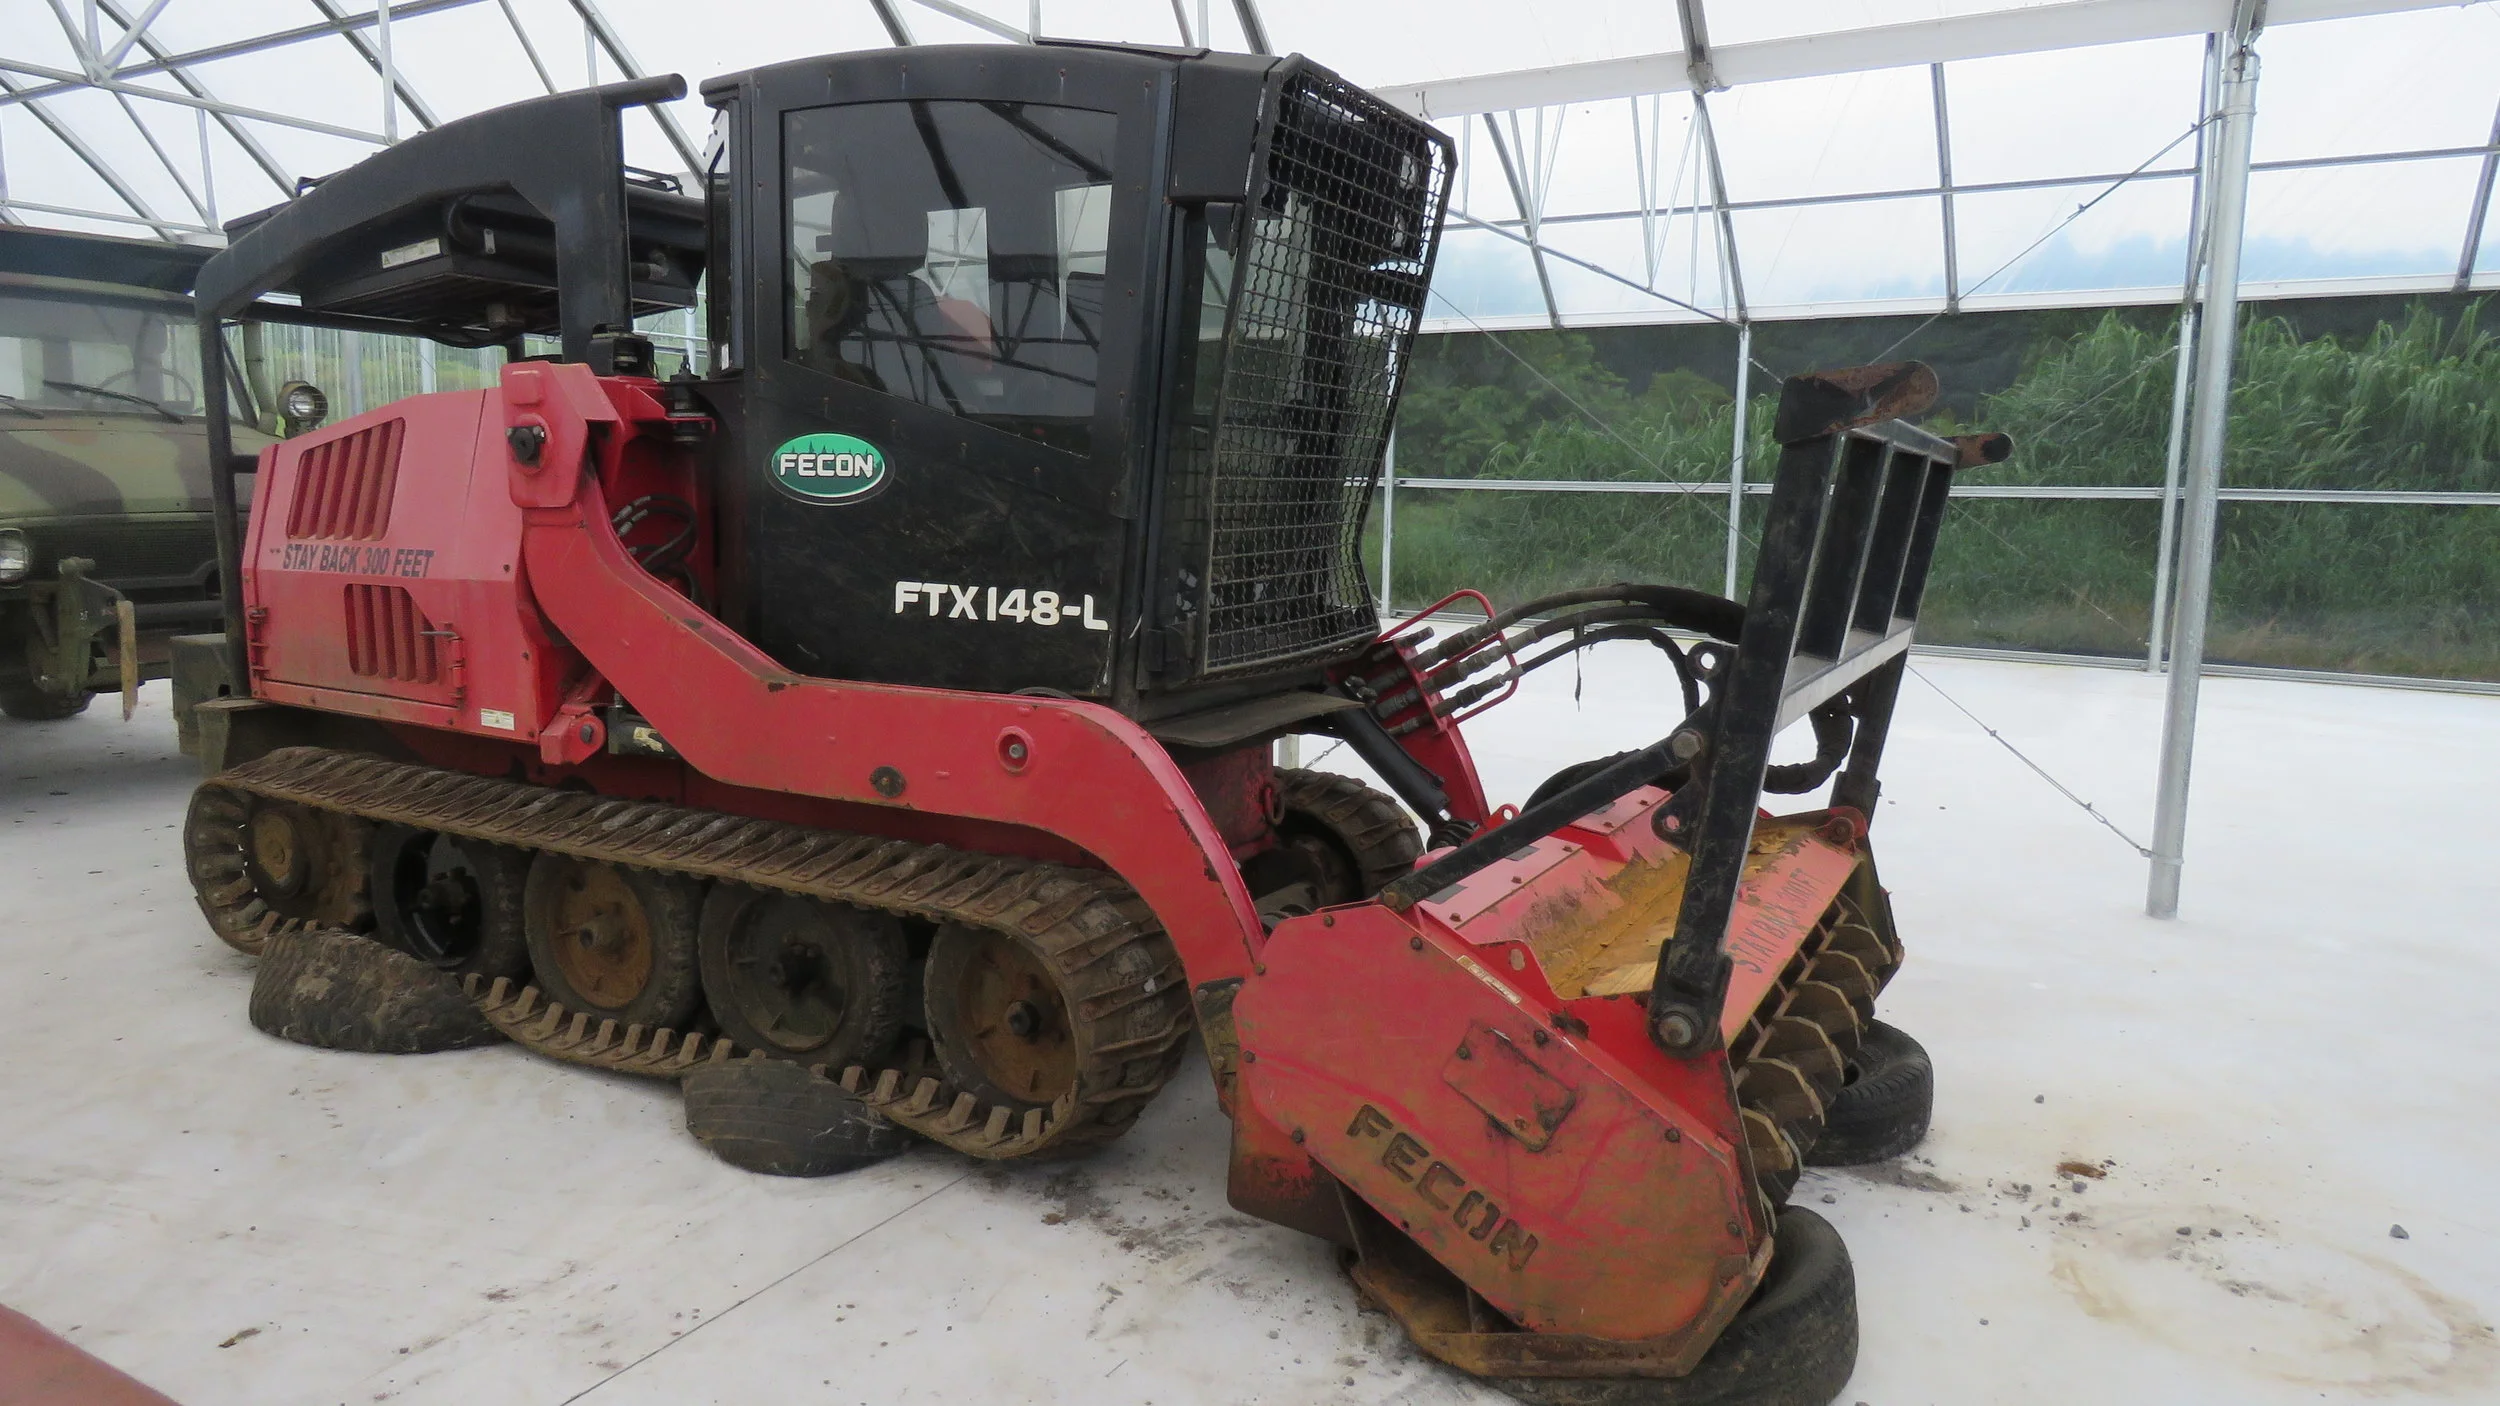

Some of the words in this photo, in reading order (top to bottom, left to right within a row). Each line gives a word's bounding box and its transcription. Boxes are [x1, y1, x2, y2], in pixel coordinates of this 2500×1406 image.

[780, 453, 873, 478] FECON
[283, 543, 320, 571] STAY
[319, 545, 362, 573] BACK
[362, 547, 390, 576] 300
[391, 549, 435, 578] FEET
[1750, 901, 1802, 940] BACK
[1730, 926, 1781, 974] STAY
[1346, 1104, 1539, 1272] FECON
